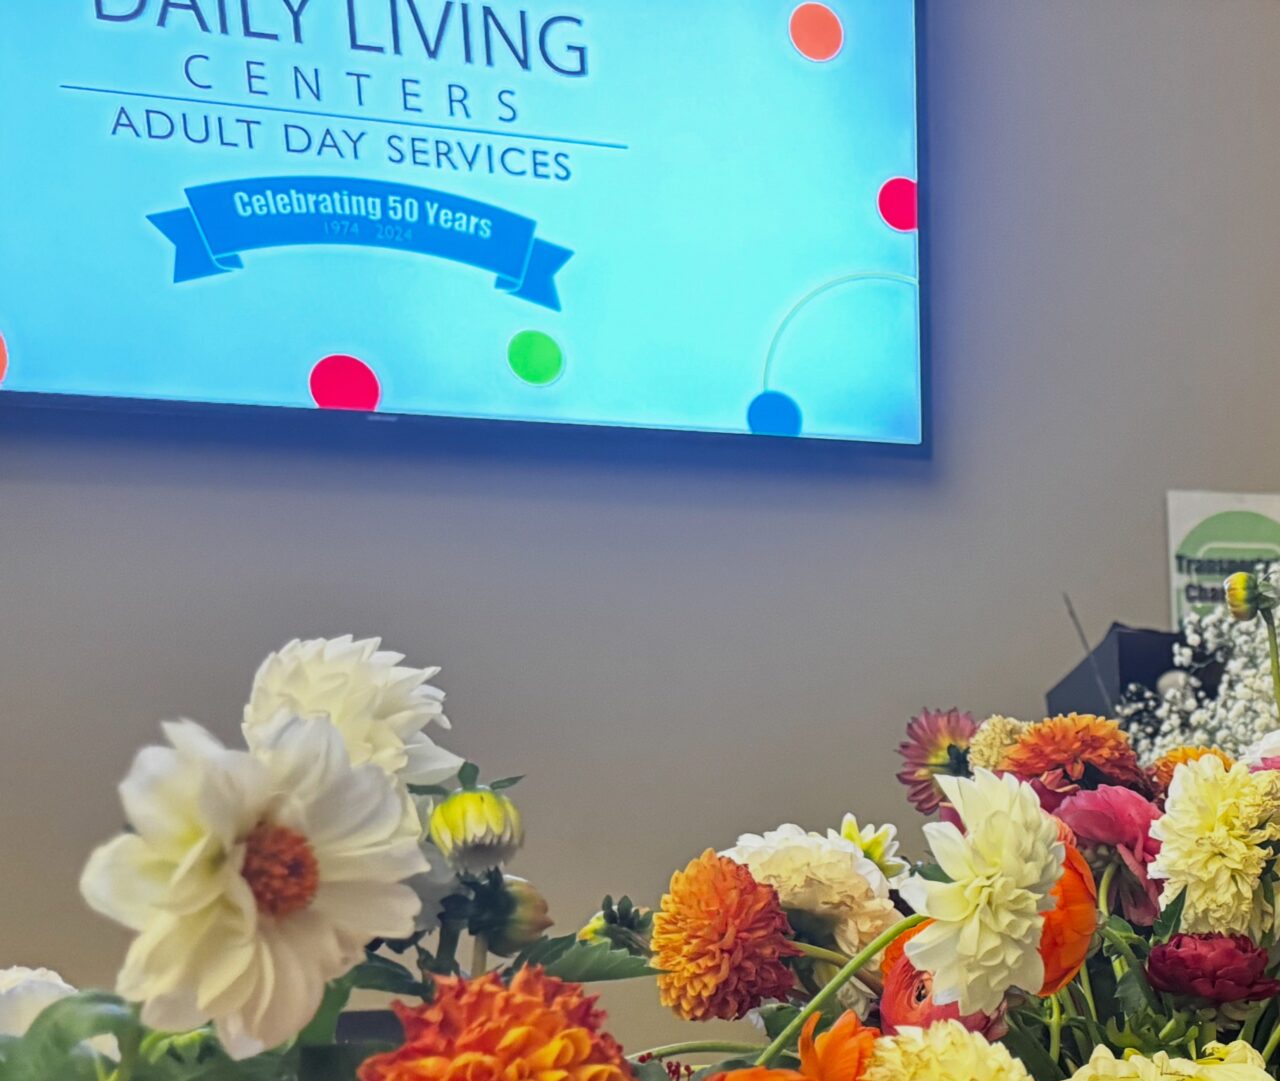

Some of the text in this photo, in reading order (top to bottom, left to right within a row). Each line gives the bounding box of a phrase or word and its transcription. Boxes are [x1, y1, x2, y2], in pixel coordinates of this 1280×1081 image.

[346, 0, 589, 77] LIVING
[184, 54, 518, 123] CENTERS
[111, 106, 572, 182] ADULT DAY SERVICES
[233, 189, 493, 239] Celebrating 50 Years
[323, 220, 413, 241] 1974 2024
